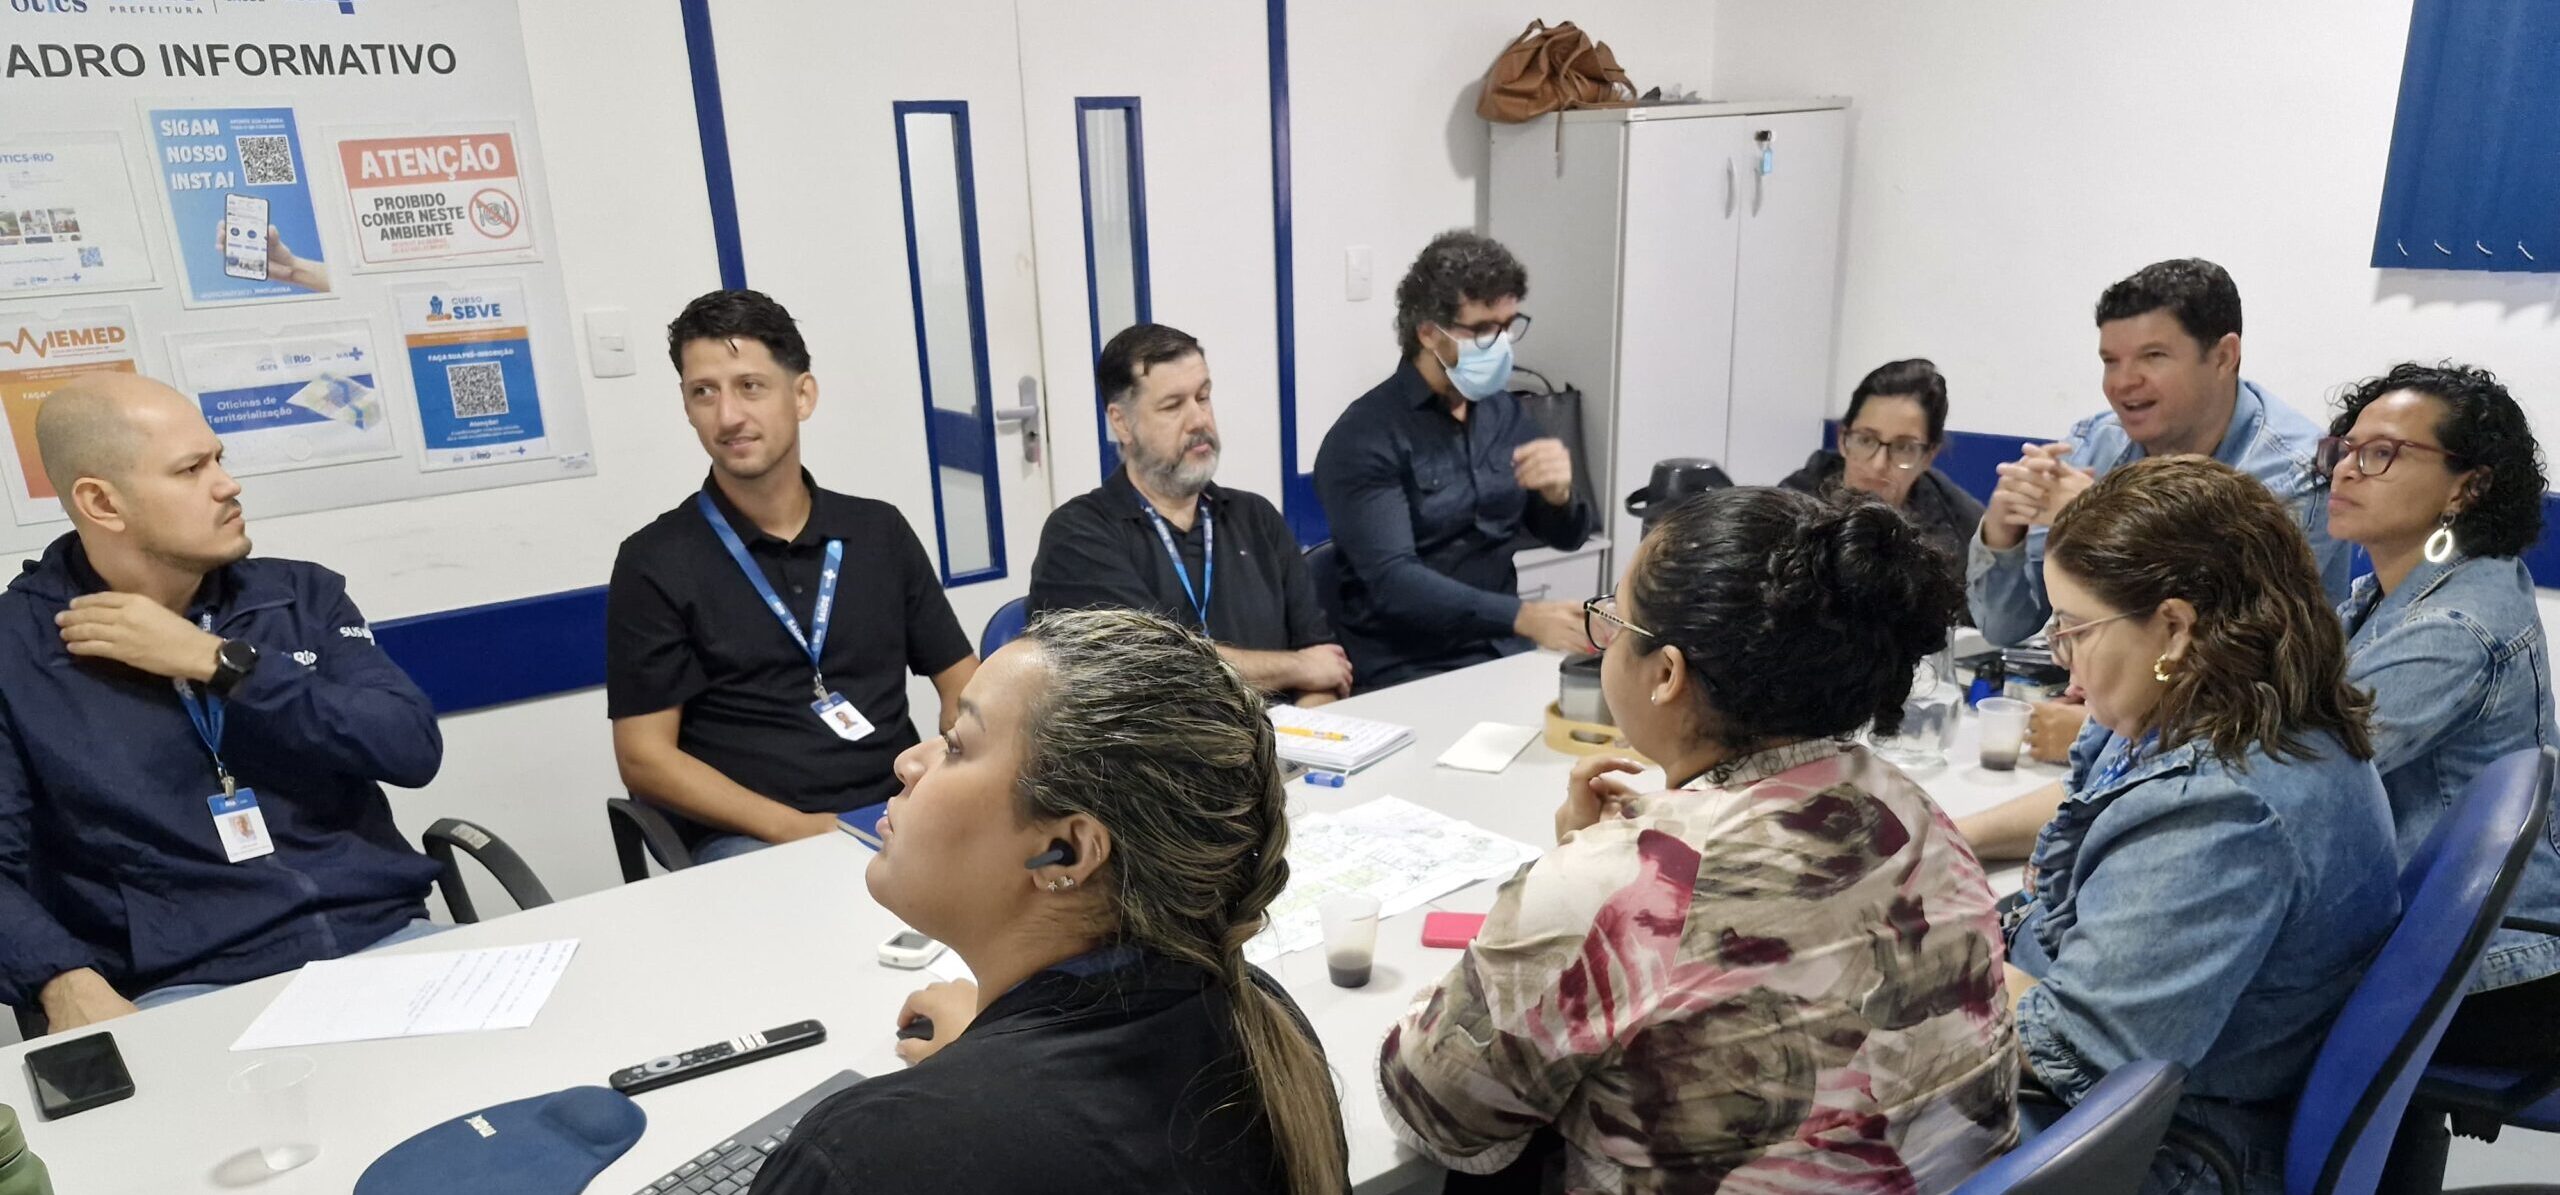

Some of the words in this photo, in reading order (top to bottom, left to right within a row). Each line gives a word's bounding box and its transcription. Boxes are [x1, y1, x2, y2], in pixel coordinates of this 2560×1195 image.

[109, 6, 203, 14] PREFEITURA
[0, 43, 145, 77] ADRO
[159, 43, 456, 77] INFORMATIVO
[160, 118, 219, 137] SIGAM
[0, 153, 54, 163] TICS-RIO
[167, 145, 228, 163] NOSSO
[361, 139, 500, 180] ATENÇÃO
[374, 193, 445, 211] PROIBIDO
[361, 211, 414, 227] COMER
[418, 206, 465, 222] NESTE
[380, 223, 454, 241] AMBIENTE
[451, 296, 482, 305] CURSO
[453, 304, 502, 320] SBVE
[216, 397, 261, 411] Oficinas
[263, 395, 277, 406] de
[207, 407, 292, 424] Territorialização
[340, 626, 363, 638] SUS
[293, 649, 317, 666] Rio
